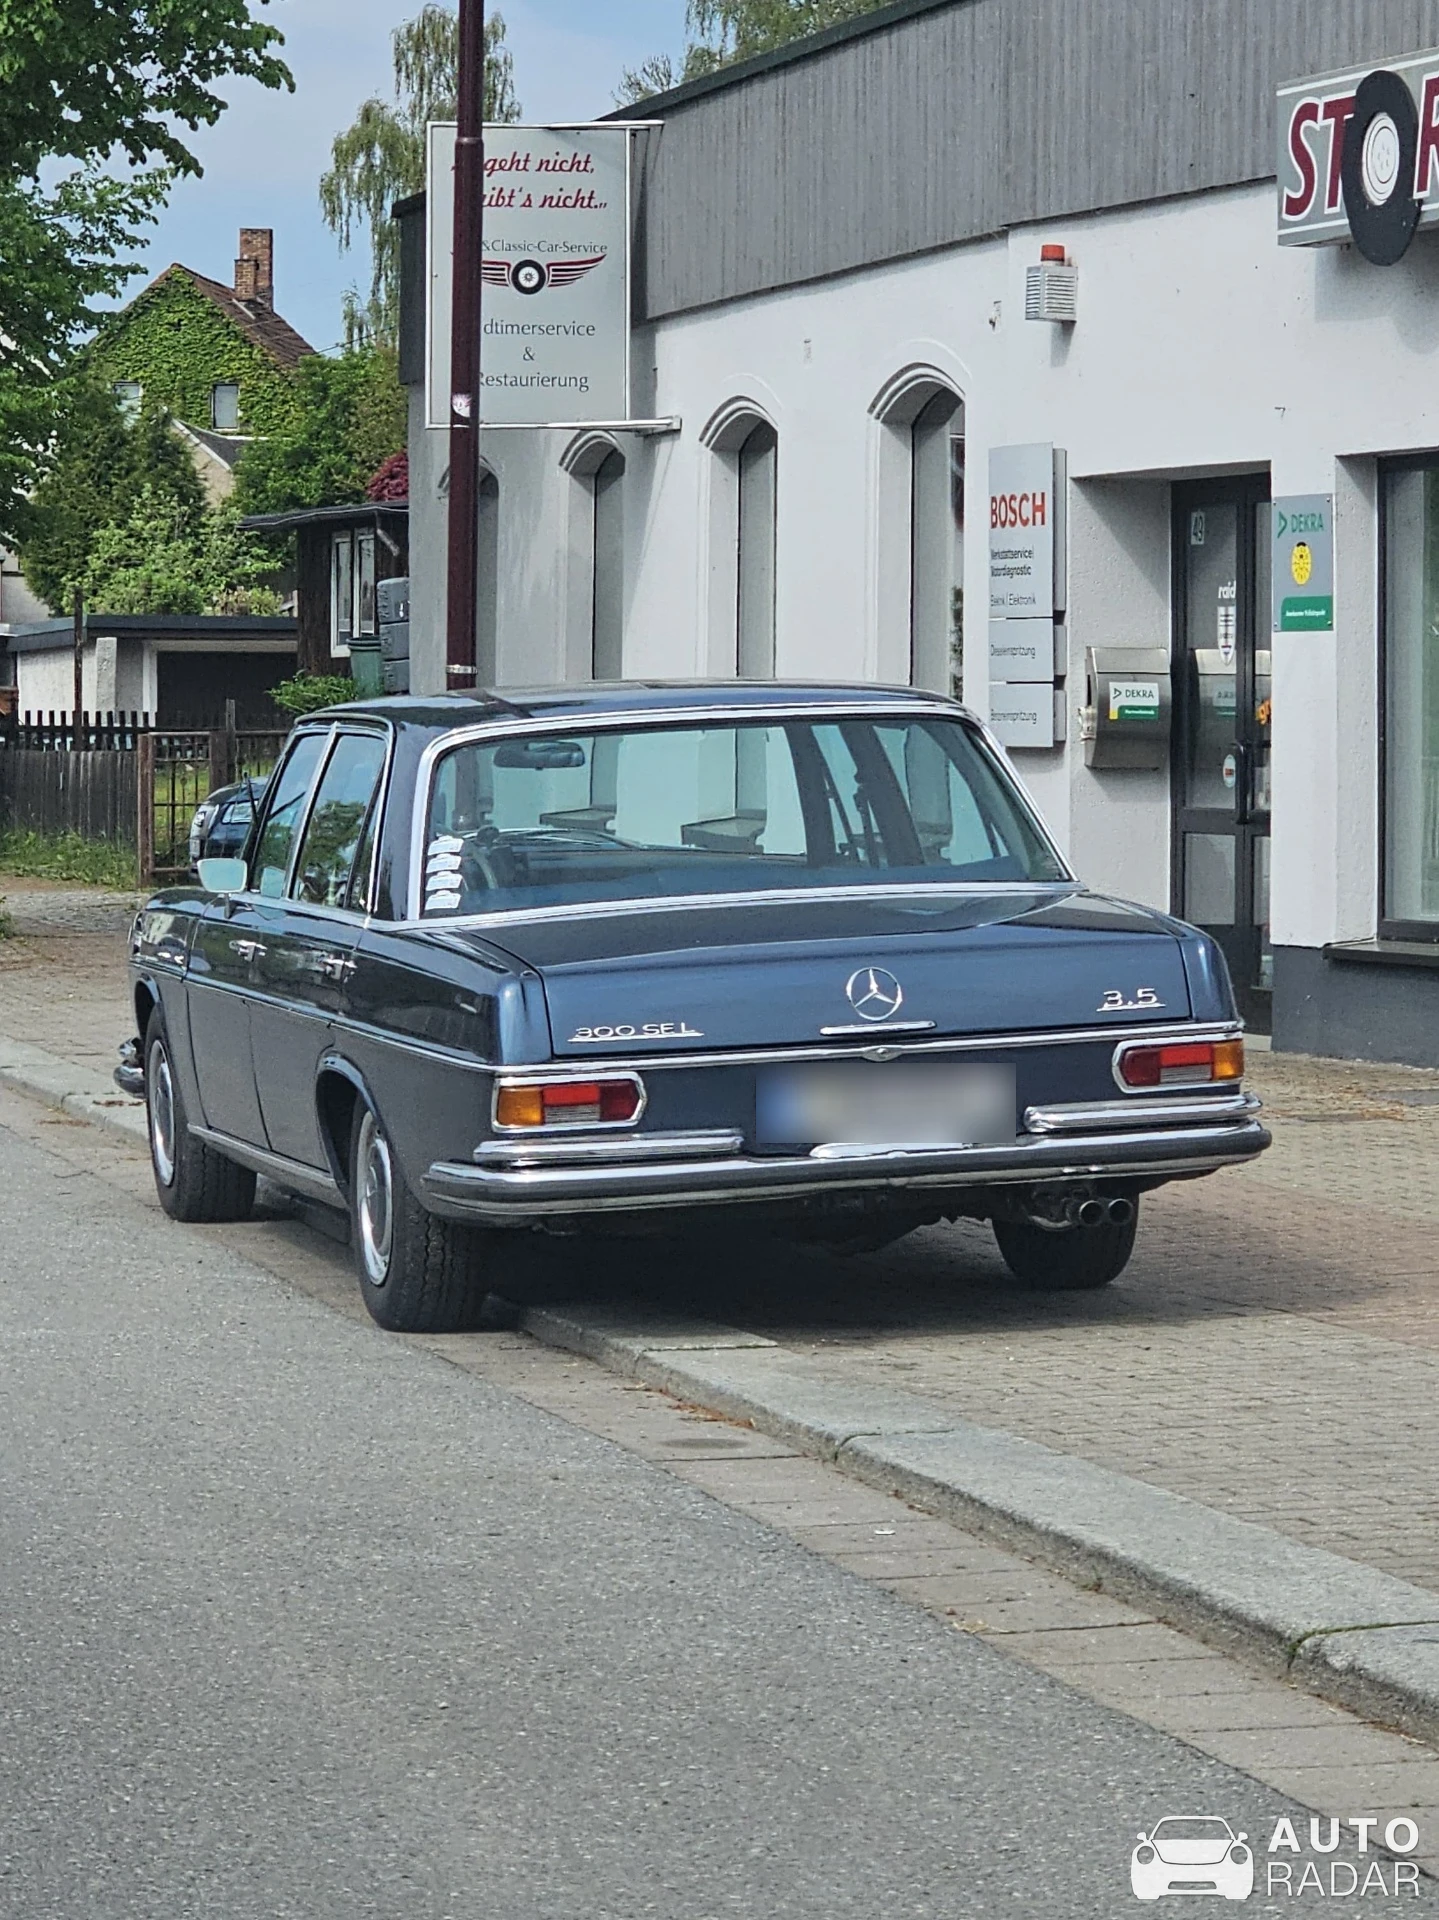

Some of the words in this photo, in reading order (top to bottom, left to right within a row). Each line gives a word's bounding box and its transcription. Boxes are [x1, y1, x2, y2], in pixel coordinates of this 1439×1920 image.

[535, 151, 595, 174] nicht,
[482, 186, 532, 208] ibt's
[483, 318, 596, 336] dtimerservice
[522, 346, 536, 362] &
[990, 492, 1045, 529] BOSCH
[1290, 512, 1325, 533] DEKRA
[1125, 689, 1154, 698] DEKRA
[1103, 987, 1158, 1008] 3.5
[575, 1025, 636, 1039] 300
